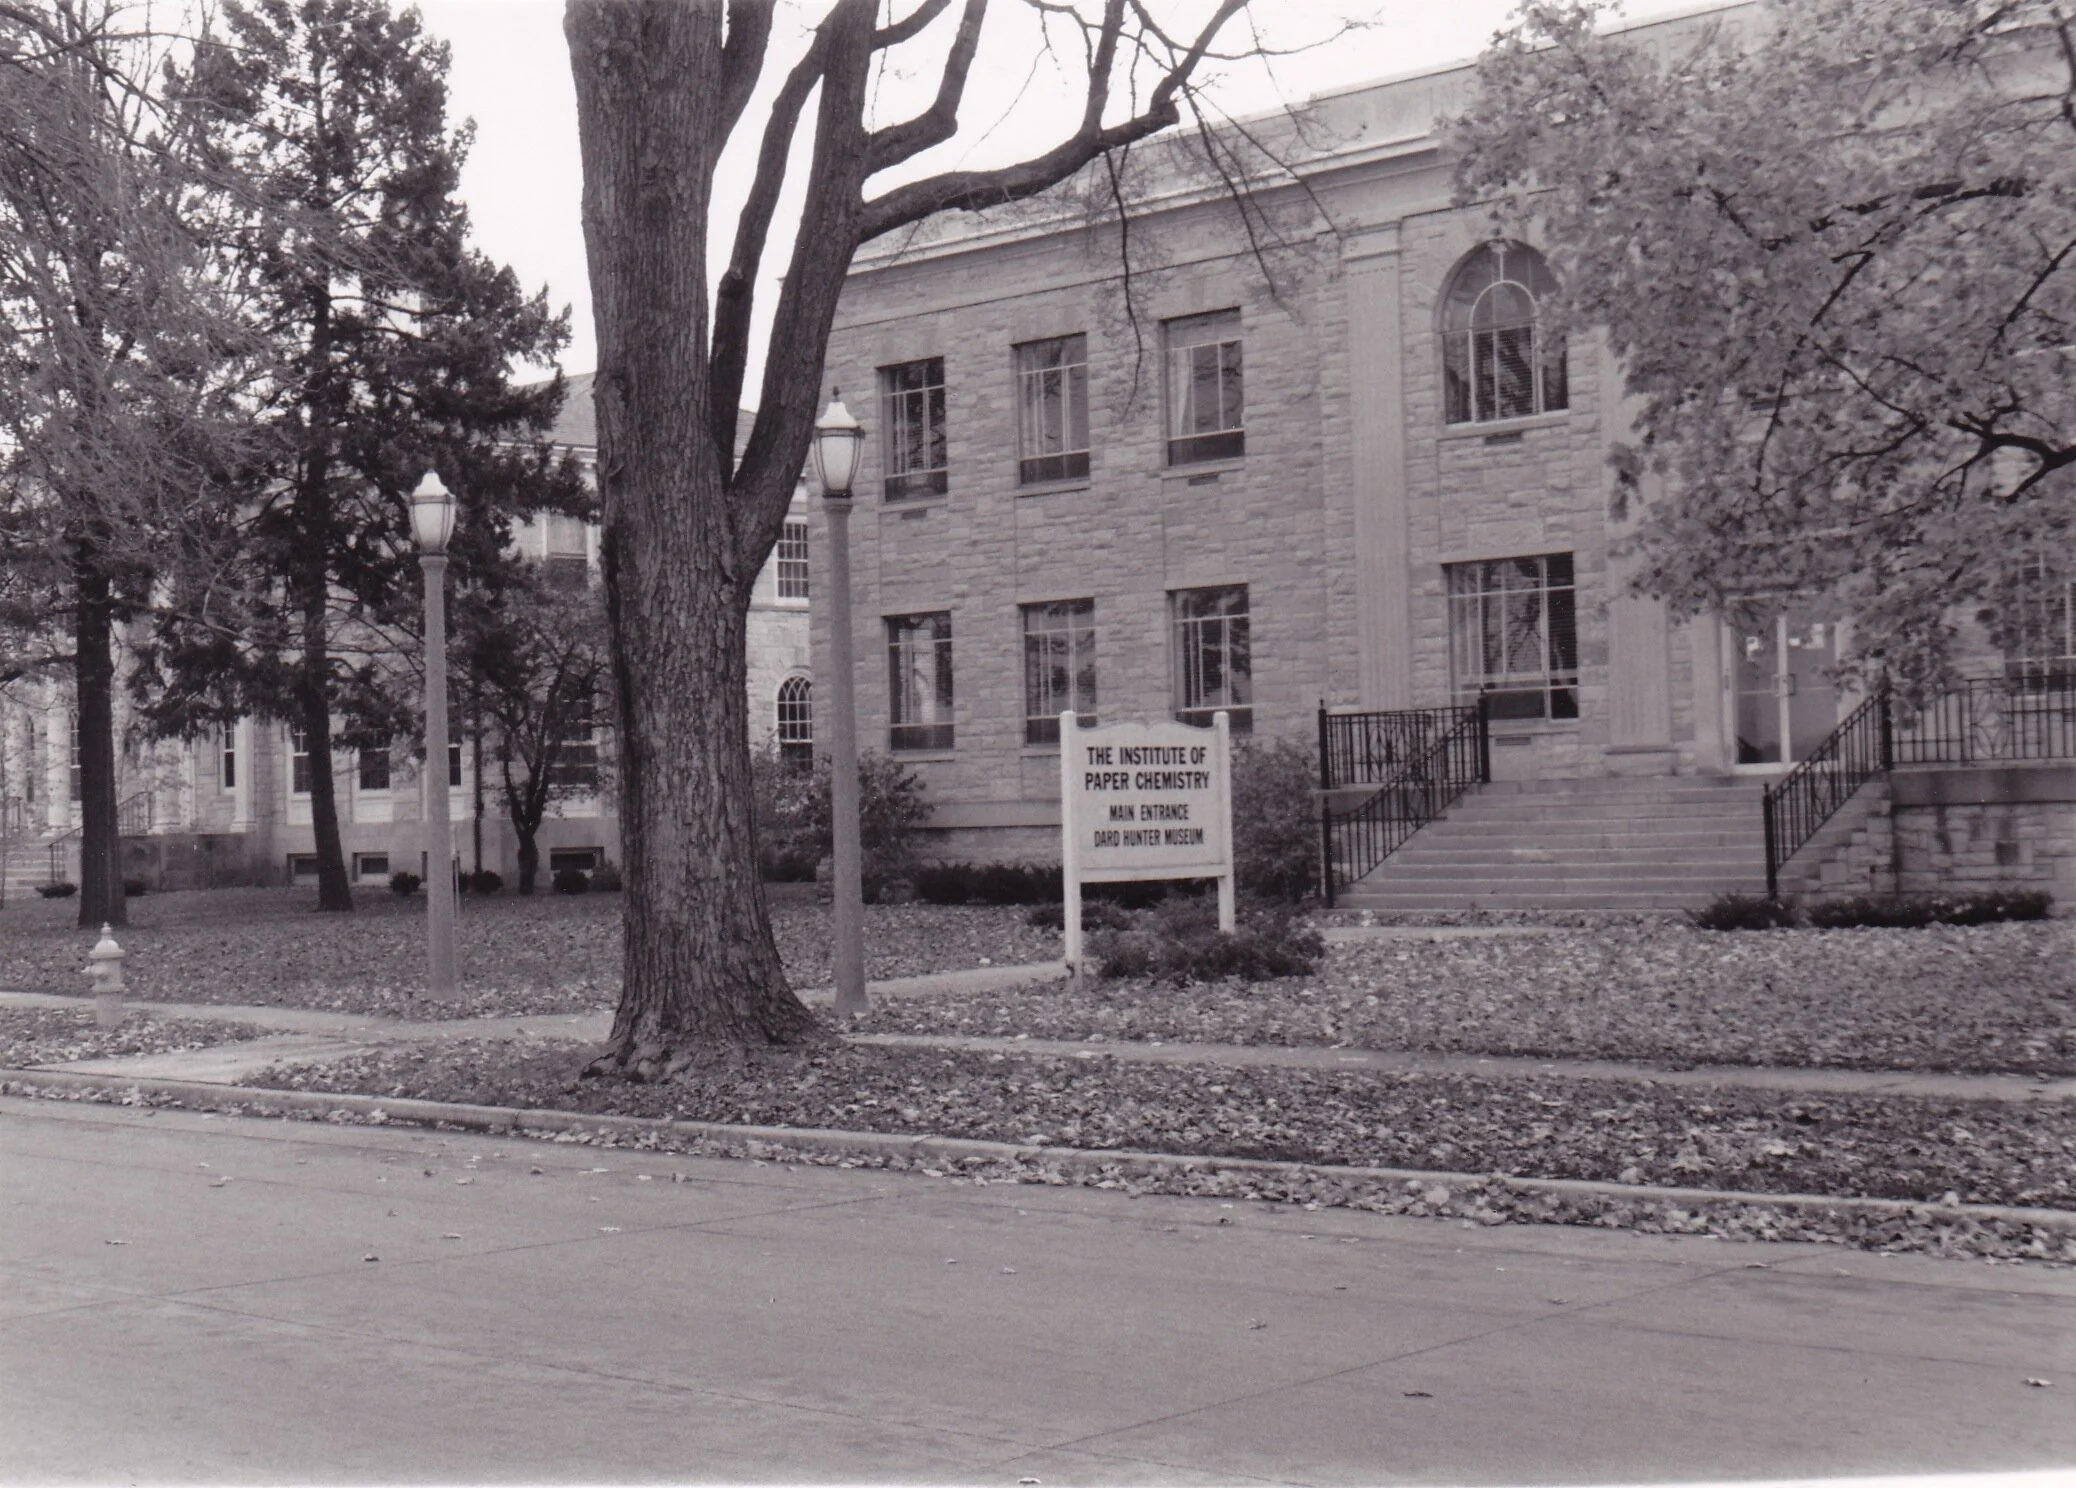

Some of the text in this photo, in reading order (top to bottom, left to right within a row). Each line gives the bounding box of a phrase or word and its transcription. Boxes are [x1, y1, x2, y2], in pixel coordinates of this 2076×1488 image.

[1086, 746, 1207, 765] THE INSTITUTE OF
[1085, 771, 1210, 790] PAPER CHEMISTRY
[1109, 804, 1189, 821] MAIN ENTRANCE
[1094, 828, 1204, 848] DARD HUNTER MUSEUM
